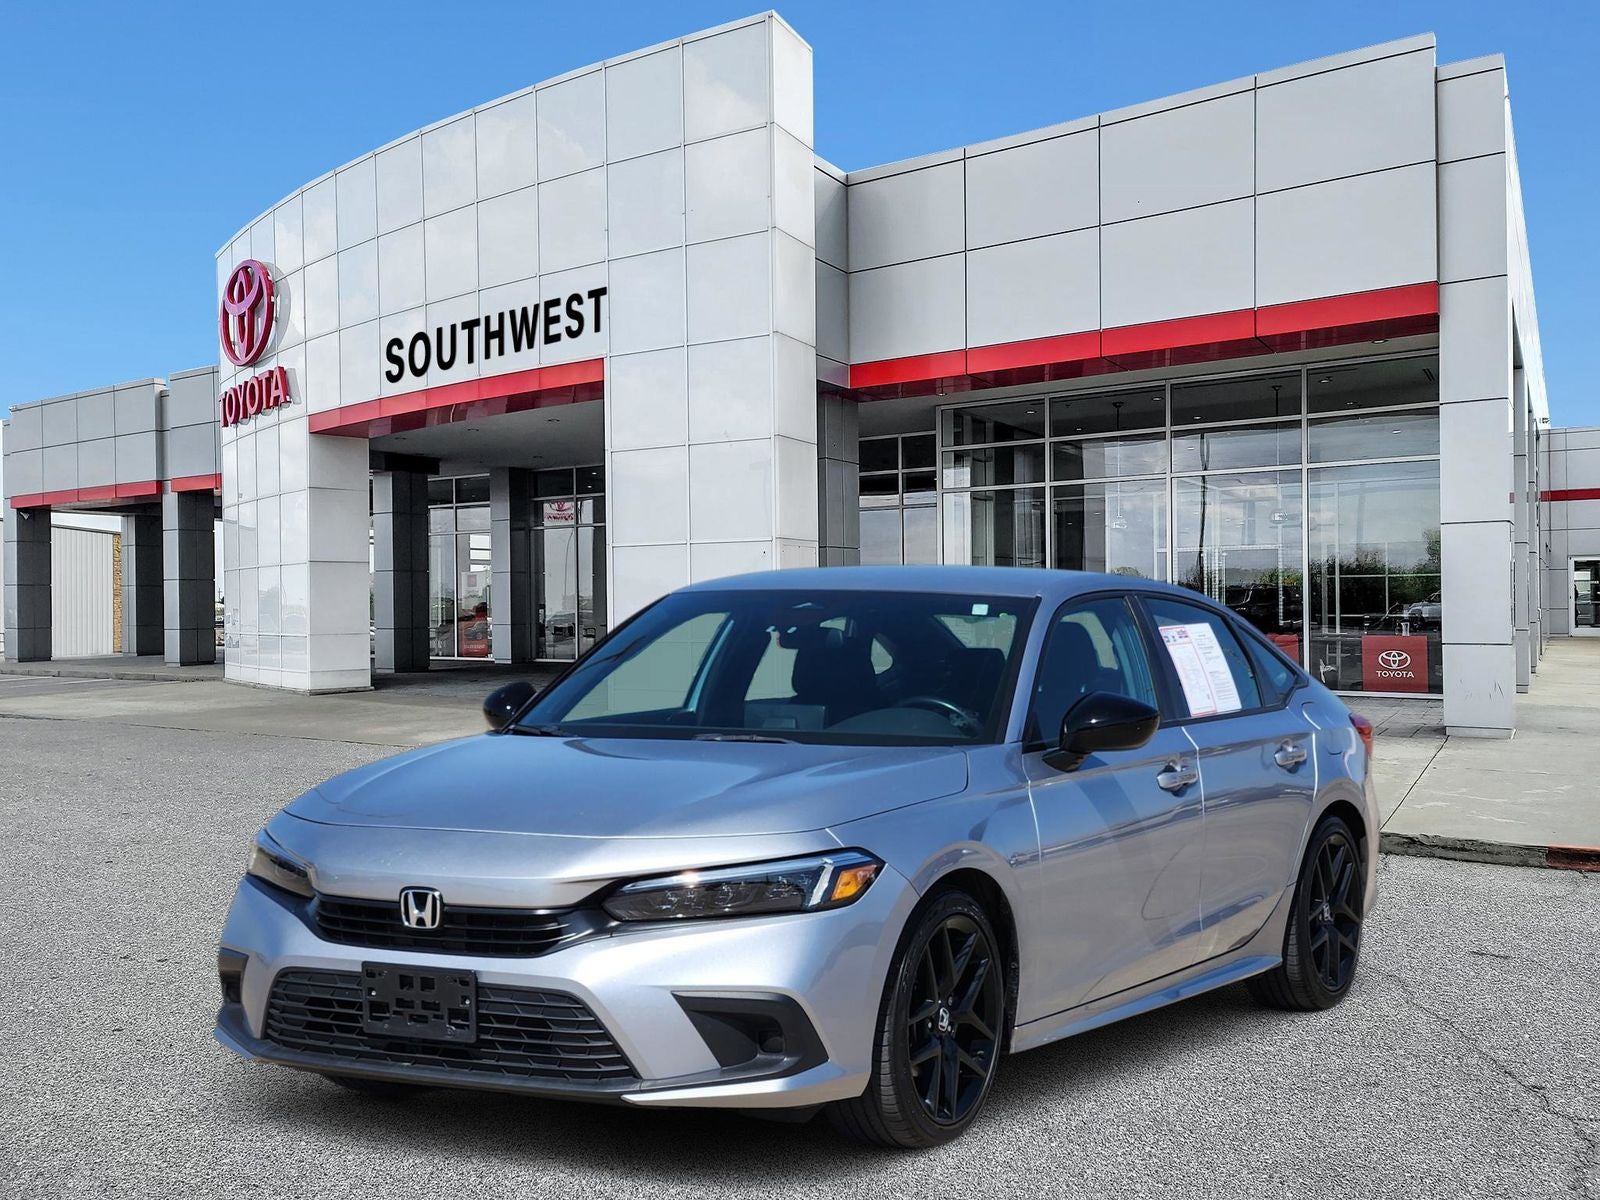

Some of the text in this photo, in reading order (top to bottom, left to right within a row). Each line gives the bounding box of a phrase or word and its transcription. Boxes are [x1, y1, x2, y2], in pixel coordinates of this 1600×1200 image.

[385, 286, 608, 383] SOUTHWEST
[218, 366, 291, 428] TOYOTA
[1376, 670, 1415, 678] TOYOTA
